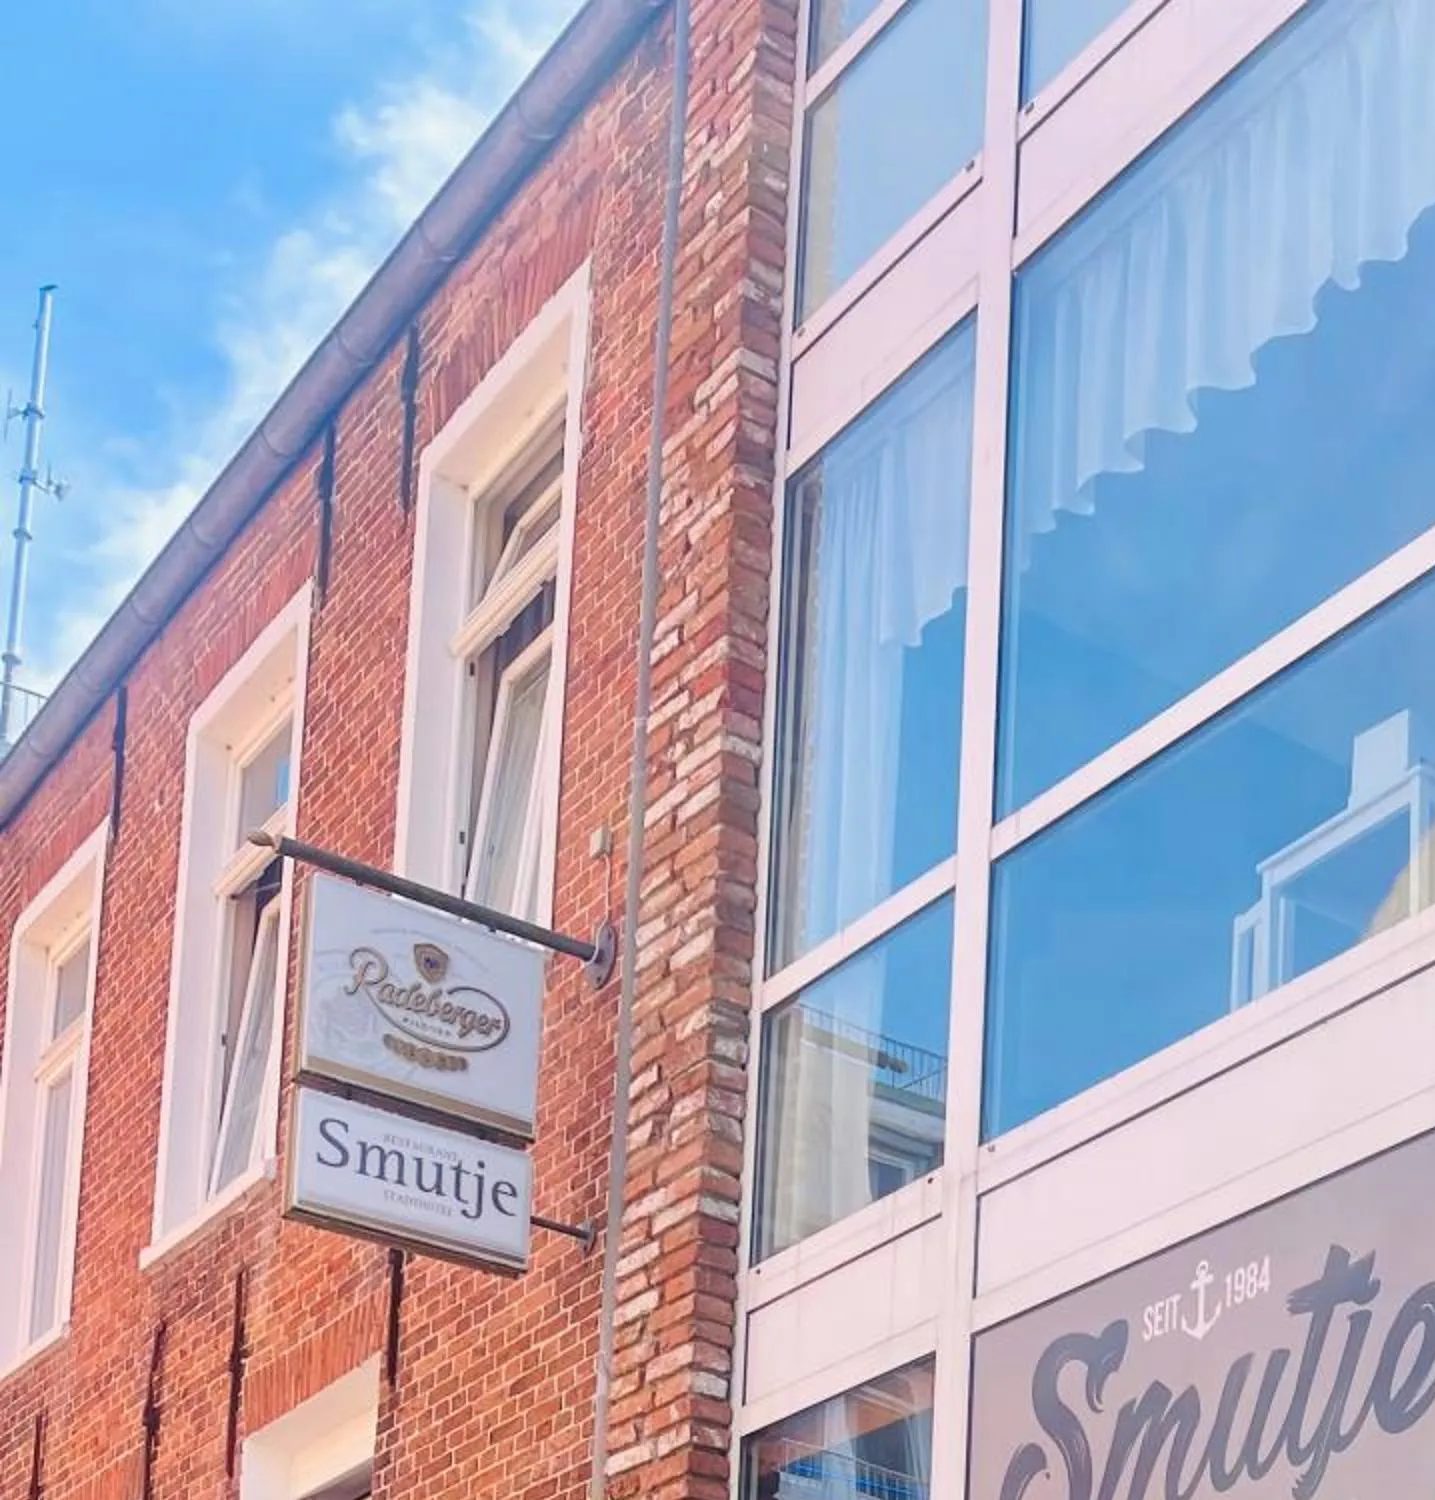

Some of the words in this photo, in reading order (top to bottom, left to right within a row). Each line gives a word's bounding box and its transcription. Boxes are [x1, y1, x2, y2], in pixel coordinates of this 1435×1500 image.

[344, 947, 508, 1042] Radeberger
[316, 1118, 518, 1219] Smutje
[1142, 1292, 1183, 1341] SEIT
[1223, 1256, 1271, 1308] 1984
